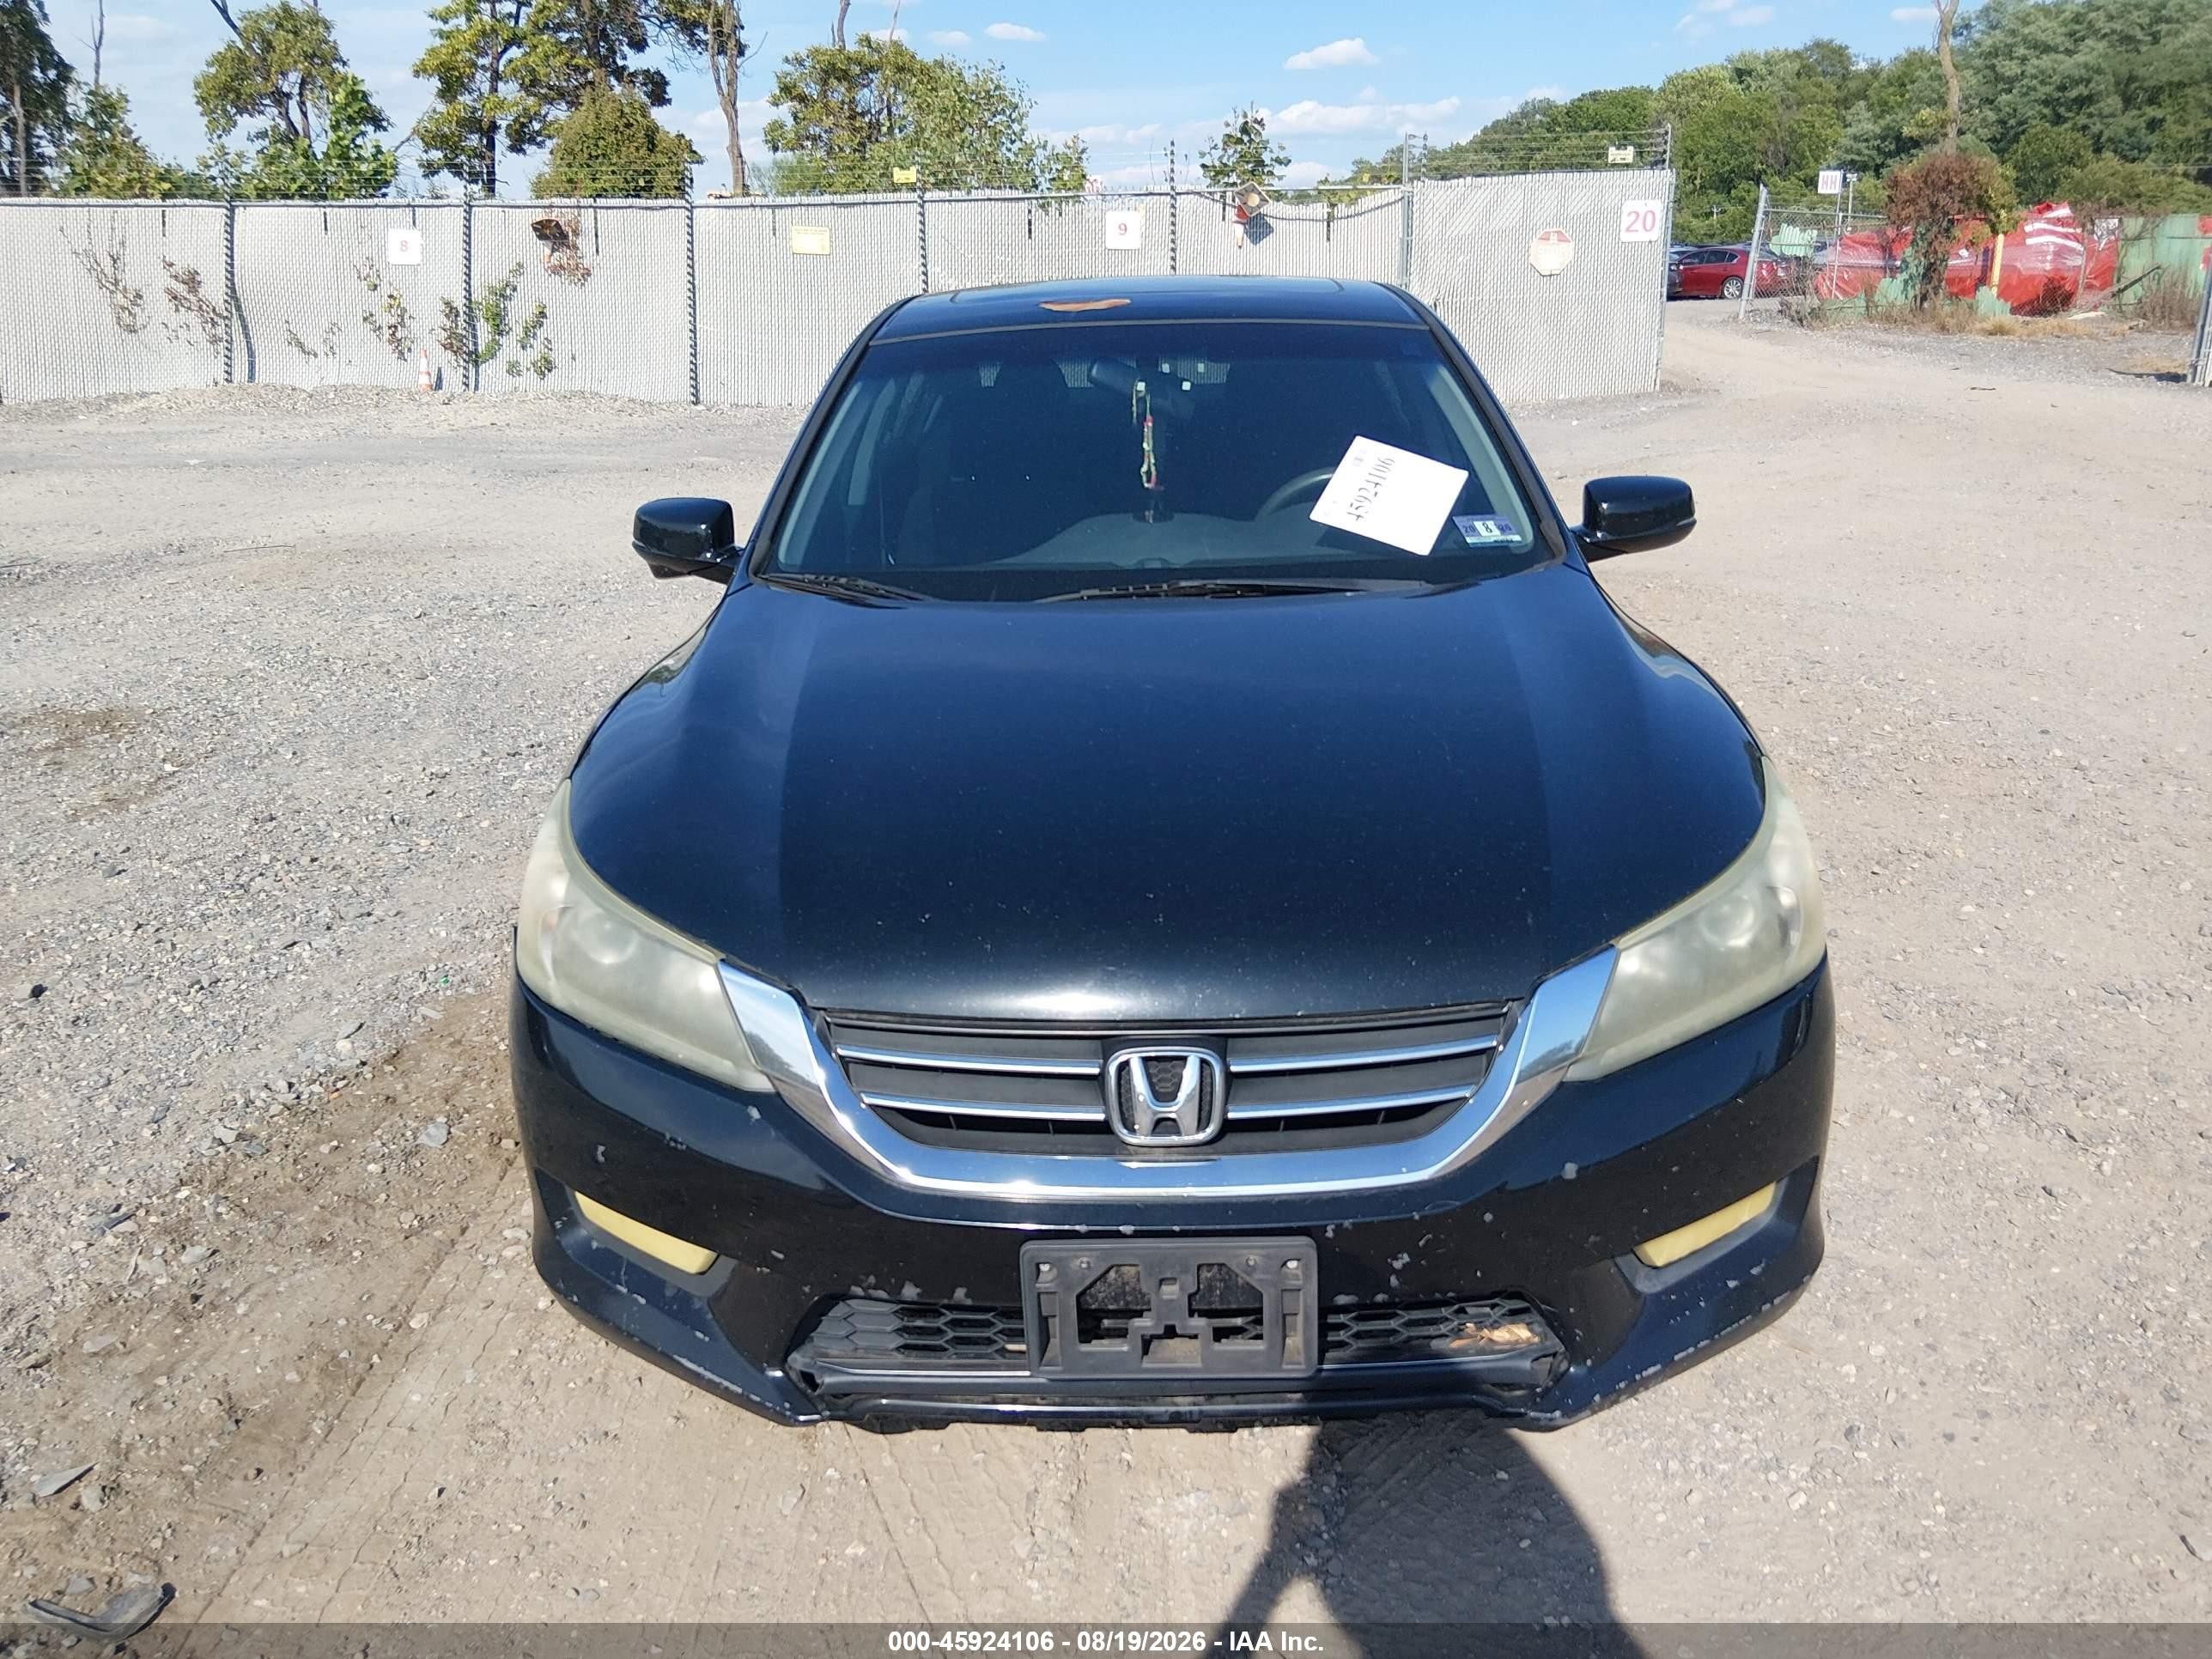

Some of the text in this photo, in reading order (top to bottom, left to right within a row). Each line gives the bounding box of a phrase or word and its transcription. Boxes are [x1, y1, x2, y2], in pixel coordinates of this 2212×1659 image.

[1625, 210, 1656, 233] 20
[1118, 222, 1127, 235] 9
[399, 240, 409, 252] 8
[1346, 457, 1395, 521] 45924106
[1482, 522, 1493, 533] 8
